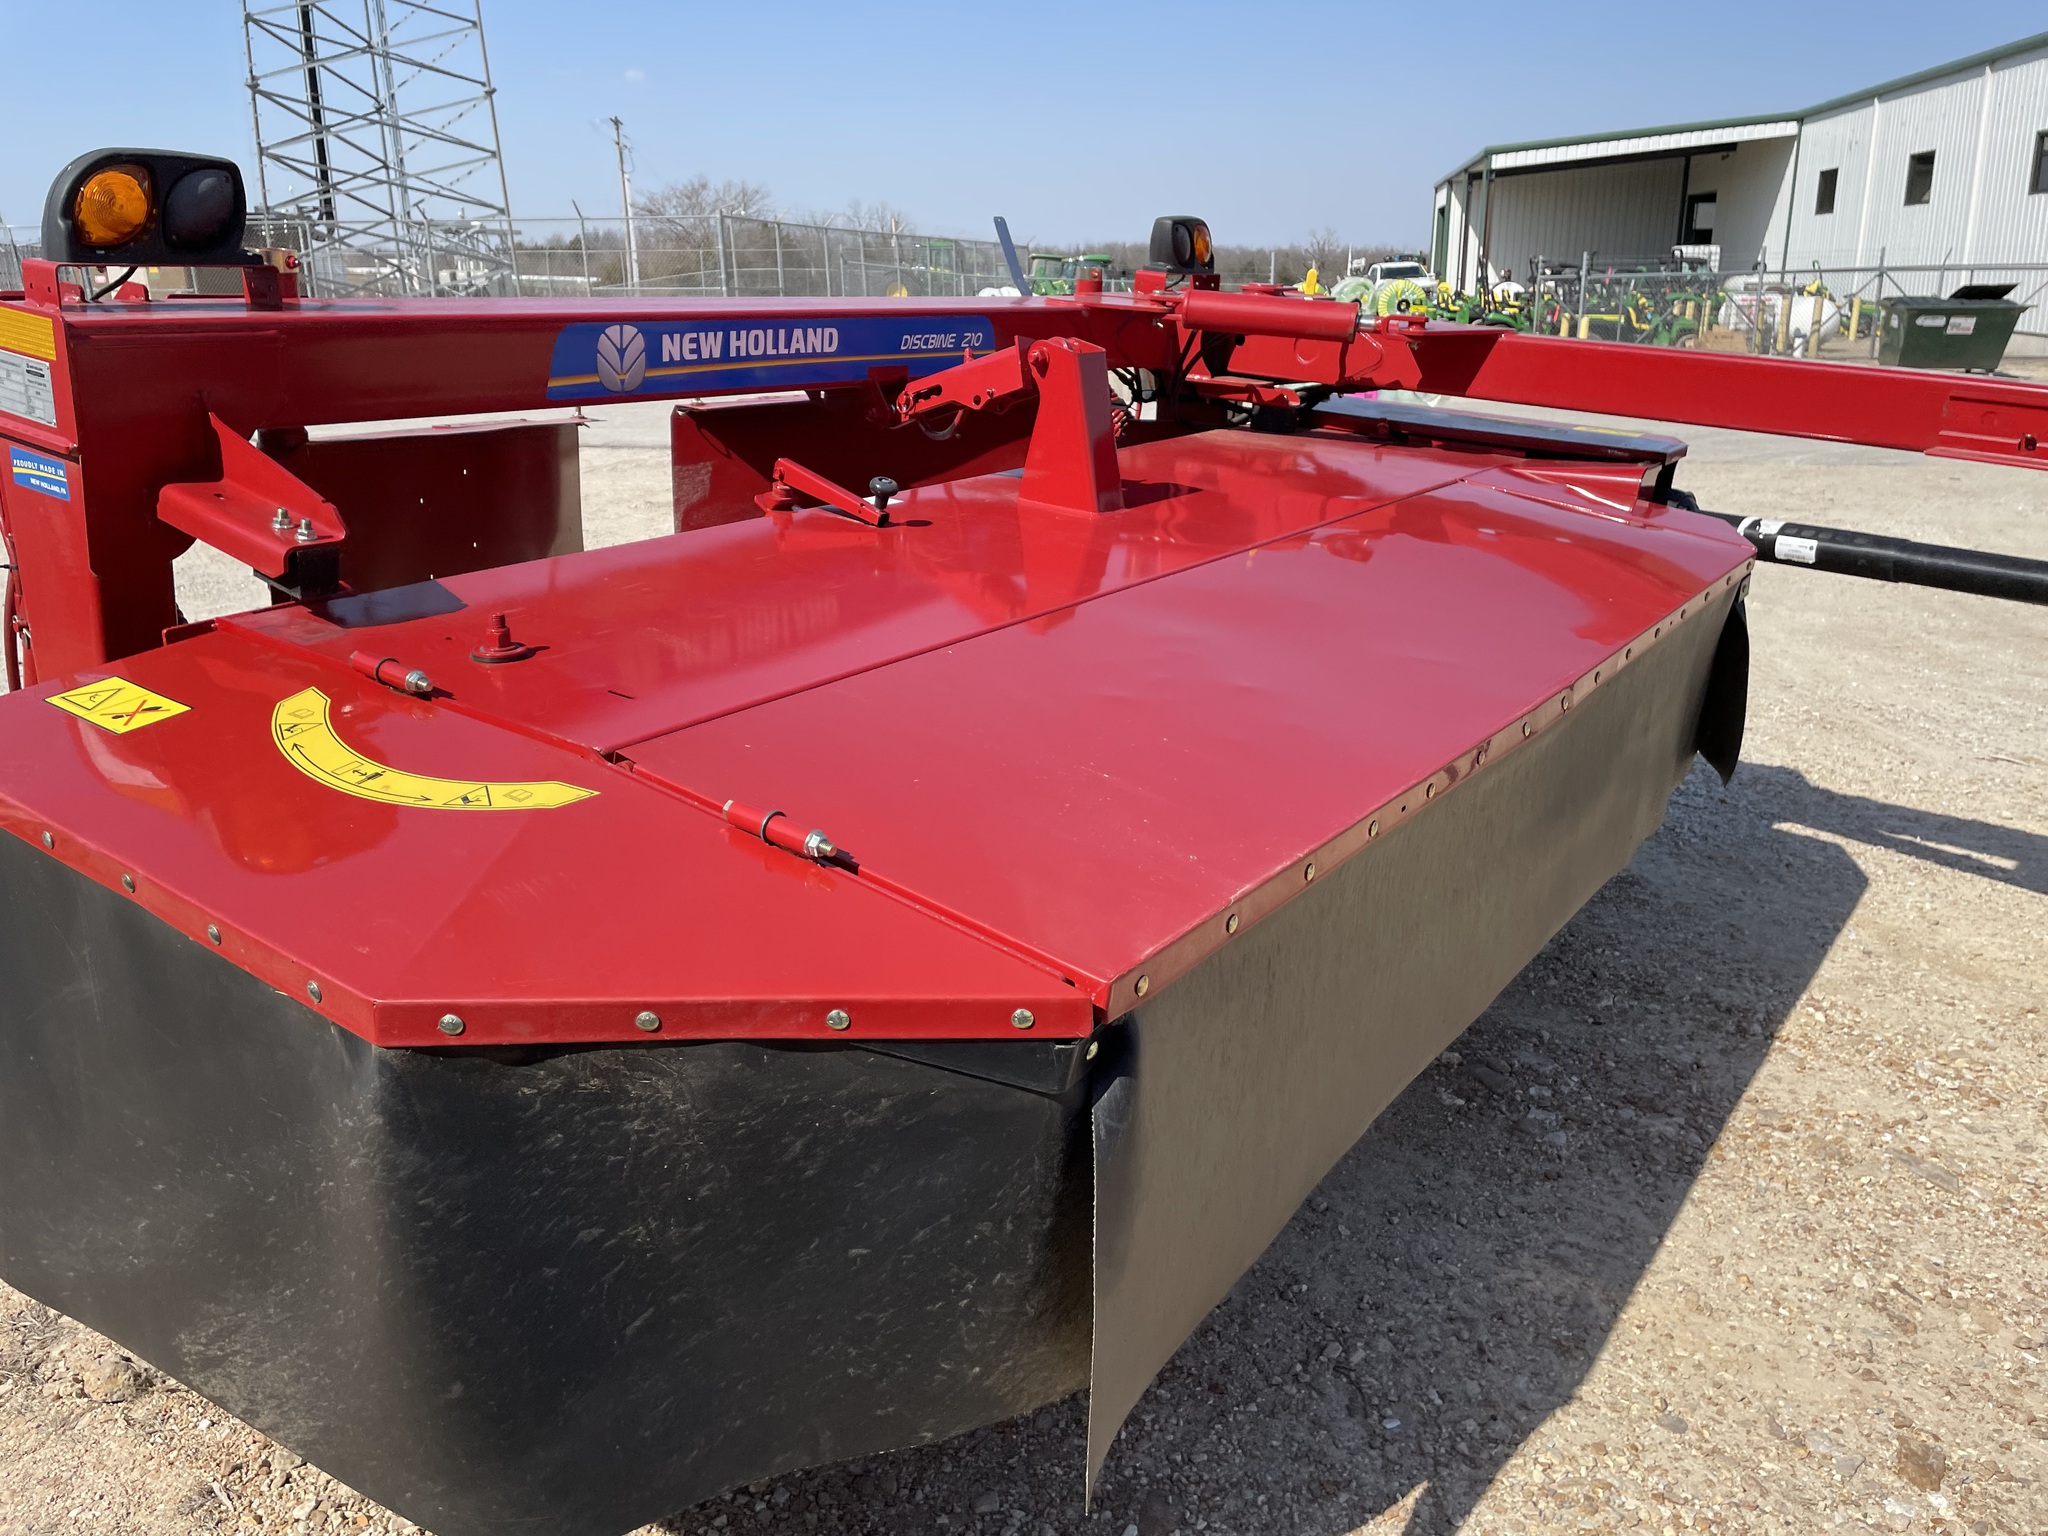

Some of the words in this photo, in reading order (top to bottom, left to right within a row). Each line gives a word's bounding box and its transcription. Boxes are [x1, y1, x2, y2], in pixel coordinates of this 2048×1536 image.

[662, 331, 723, 362] NEW
[729, 327, 838, 358] HOLLAND
[900, 333, 957, 350] DISCBINE
[961, 332, 983, 347] 210
[13, 459, 38, 469] PROUDLY
[39, 463, 55, 474] MADE
[57, 469, 64, 477] IN
[30, 477, 40, 486] NEW
